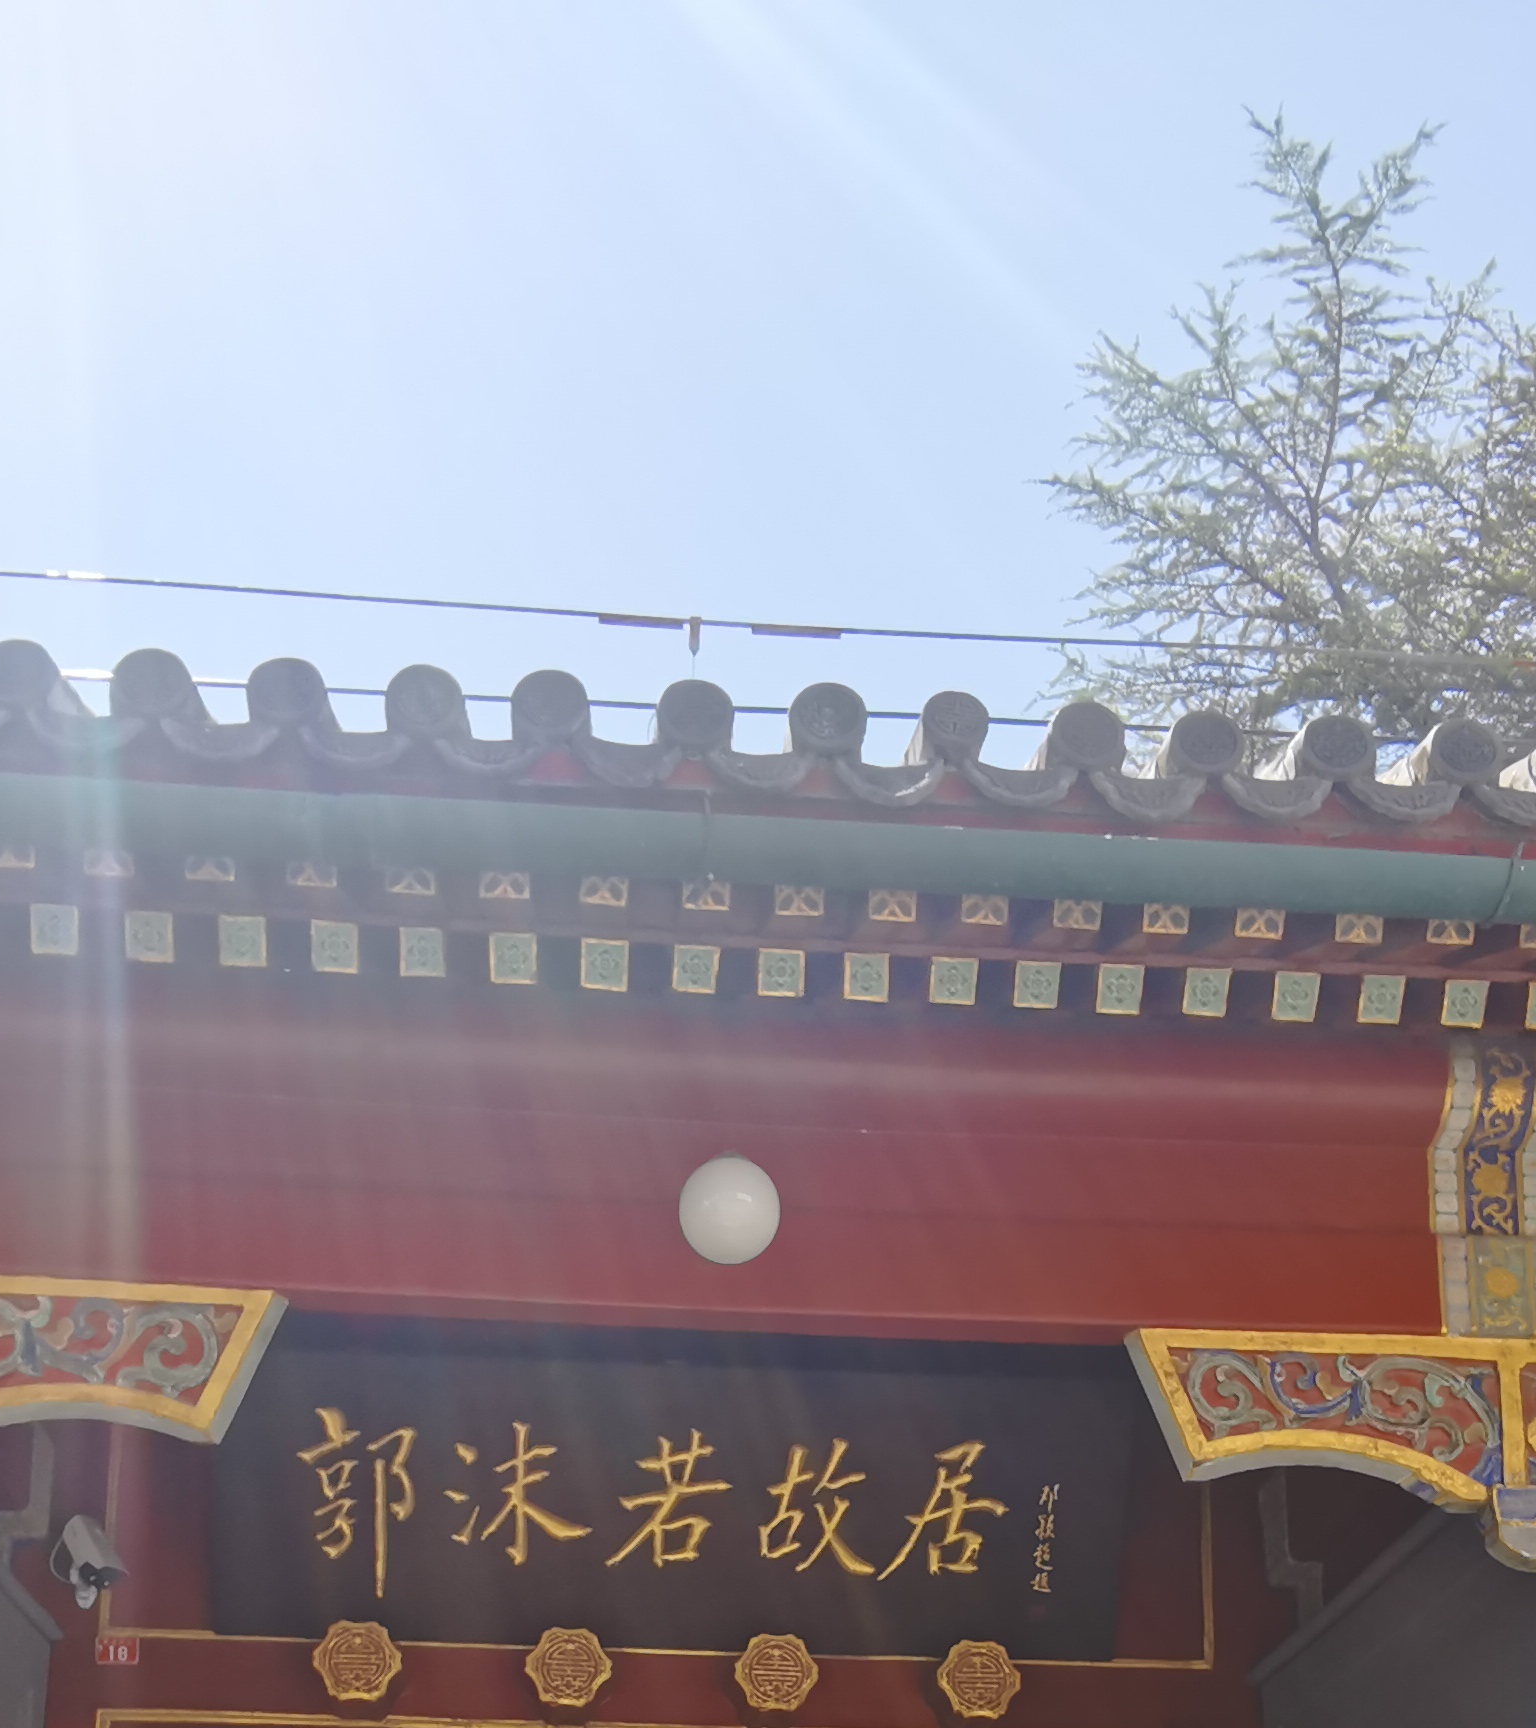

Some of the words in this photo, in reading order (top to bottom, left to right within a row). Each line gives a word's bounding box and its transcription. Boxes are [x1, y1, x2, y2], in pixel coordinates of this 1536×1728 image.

[296, 1407, 1010, 1597] 郭沫若故居
